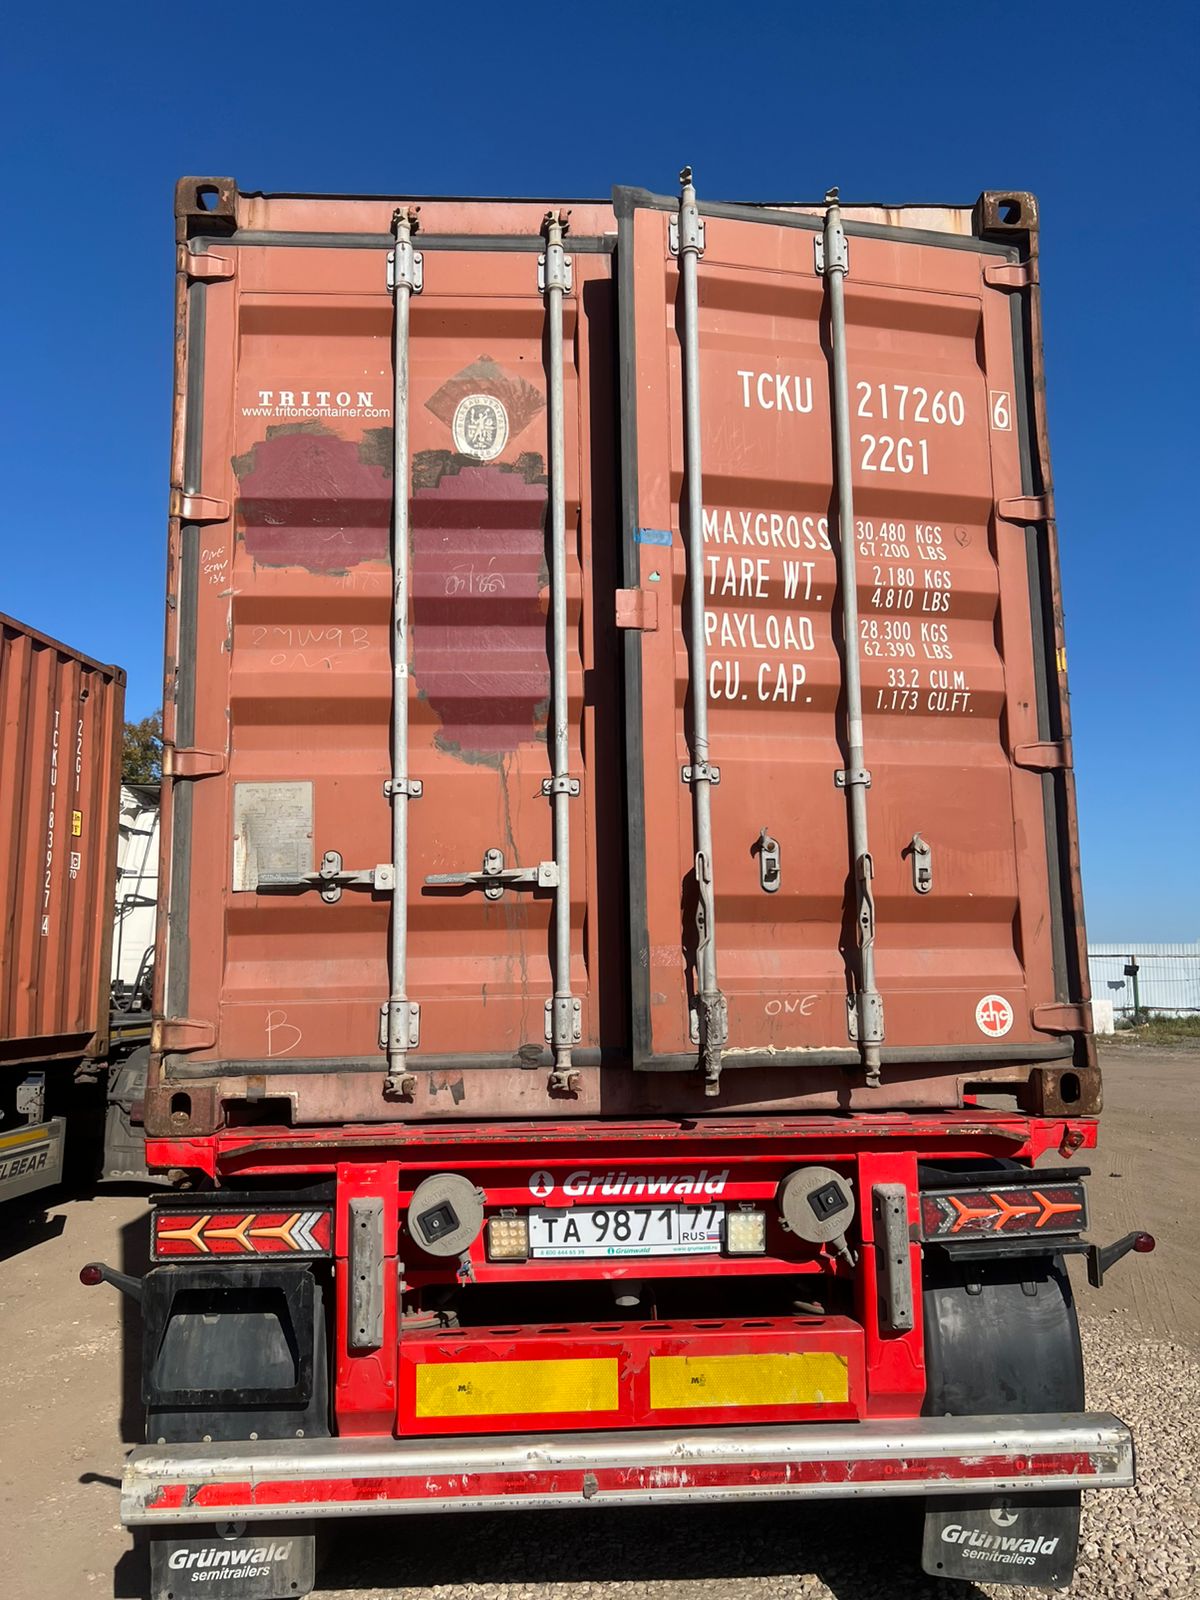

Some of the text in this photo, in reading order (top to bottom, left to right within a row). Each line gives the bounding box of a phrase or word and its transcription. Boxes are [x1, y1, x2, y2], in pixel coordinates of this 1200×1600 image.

[258, 391, 374, 407] TRITON
[736, 369, 813, 414] TCKU
[855, 380, 1010, 430] 217260 6
[241, 406, 391, 419] www.tritoncontainer.com
[859, 433, 930, 476] 22G1
[702, 508, 833, 551] MAXGROSS
[915, 524, 942, 545] KGS
[919, 545, 947, 561] LBS
[707, 556, 770, 599] TARE
[783, 560, 823, 601] WT.
[924, 568, 952, 590] KGS
[922, 591, 951, 613] LBS
[704, 611, 816, 651] PAYLOAD
[920, 623, 948, 643] KGS
[923, 644, 953, 660] LBS
[709, 660, 970, 703] CU. CAP. 33.2 CU.M.
[927, 691, 974, 713] CU.FT.
[50, 710, 60, 786] TCKU
[75, 719, 84, 792] 22G1
[44, 792, 55, 908] 183927
[764, 994, 820, 1017] ONE
[264, 1007, 303, 1057] B
[562, 1169, 731, 1197] Grünwald
[542, 1204, 718, 1244] TA 9871 77
[682, 1231, 706, 1241] RUS
[615, 1246, 651, 1255] Grünwald
[940, 1524, 1060, 1556] Grünwald
[167, 1541, 293, 1570] Grünwald
[961, 1547, 1037, 1566] semitrailers
[191, 1565, 271, 1582] semitrailers
